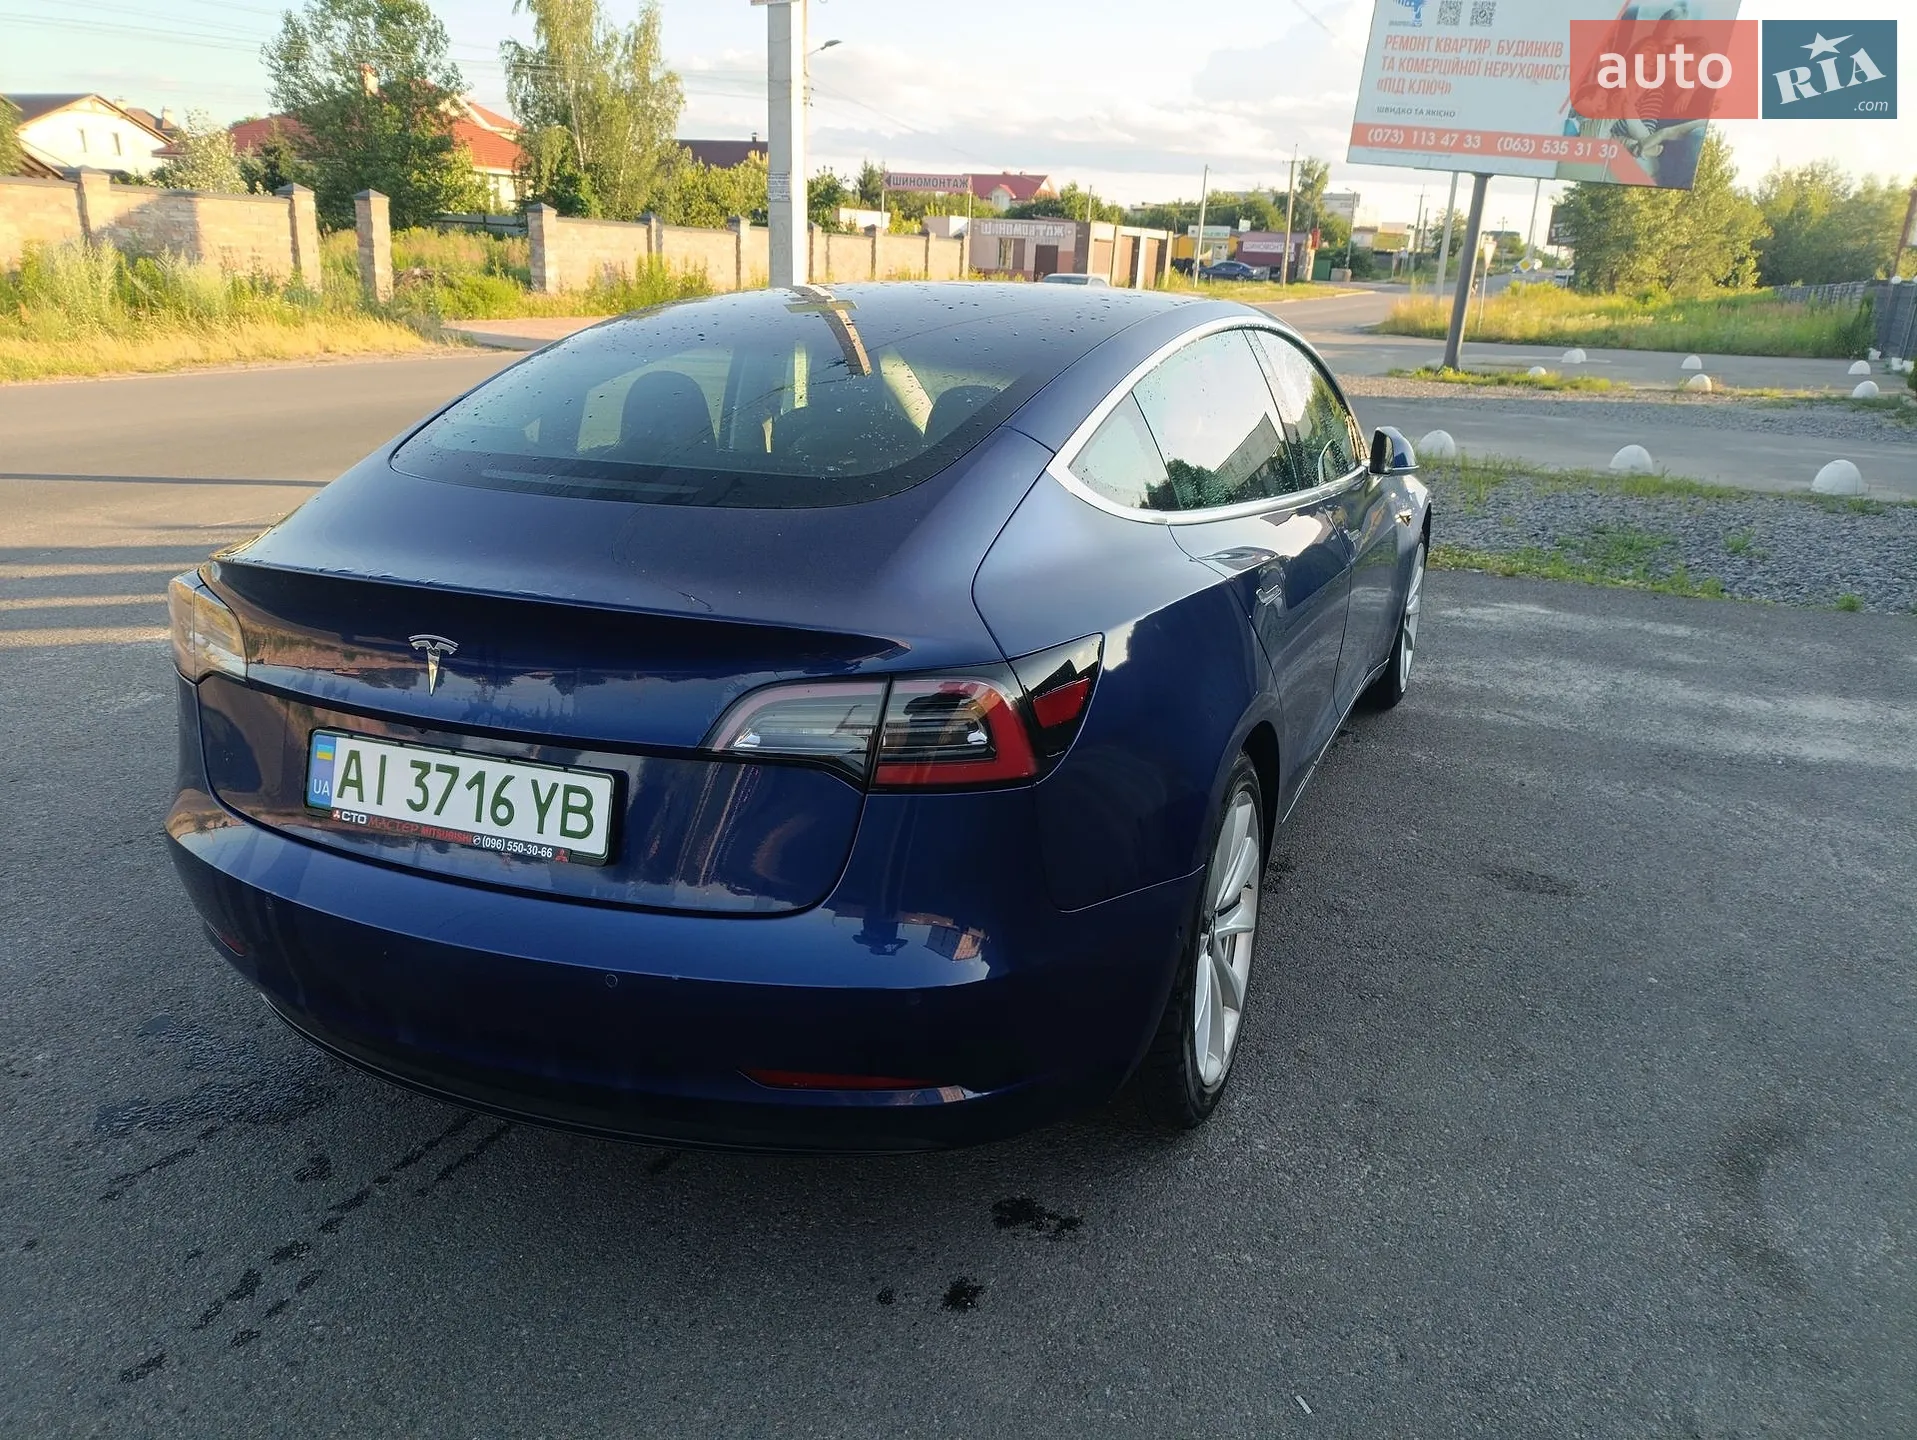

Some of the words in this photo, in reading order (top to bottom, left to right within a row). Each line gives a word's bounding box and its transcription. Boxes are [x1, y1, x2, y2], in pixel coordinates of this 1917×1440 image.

[1384, 35, 1434, 52] РЕМОНТ
[1497, 39, 1564, 58] БУДИНКІВ
[1382, 55, 1395, 71] ТА
[1398, 57, 1483, 77] КОМЕРЦІЙНОЇ
[1484, 61, 1570, 81] НЕРУХОМОСТ
[1376, 106, 1412, 116] ШВИДКО
[1414, 107, 1424, 116] ТА
[1425, 109, 1456, 118] ЯКІСНО
[1367, 127, 1404, 145] (073)
[1412, 131, 1436, 146] 113
[1440, 132, 1459, 147] 47
[1463, 134, 1481, 149] 33
[1497, 136, 1536, 154] (063)
[1542, 139, 1569, 155] 535
[1574, 141, 1592, 157] 31
[1599, 143, 1618, 159] 30
[892, 176, 968, 188] ШИНОМОНТАЖ
[313, 779, 330, 795] UA
[337, 750, 387, 805] AI
[406, 760, 515, 827] 3716
[531, 779, 594, 839] YB
[341, 811, 367, 825] СТО
[420, 825, 472, 845] MITSUBISHI
[482, 835, 505, 851] (096)
[507, 840, 553, 858] 550-30-66
